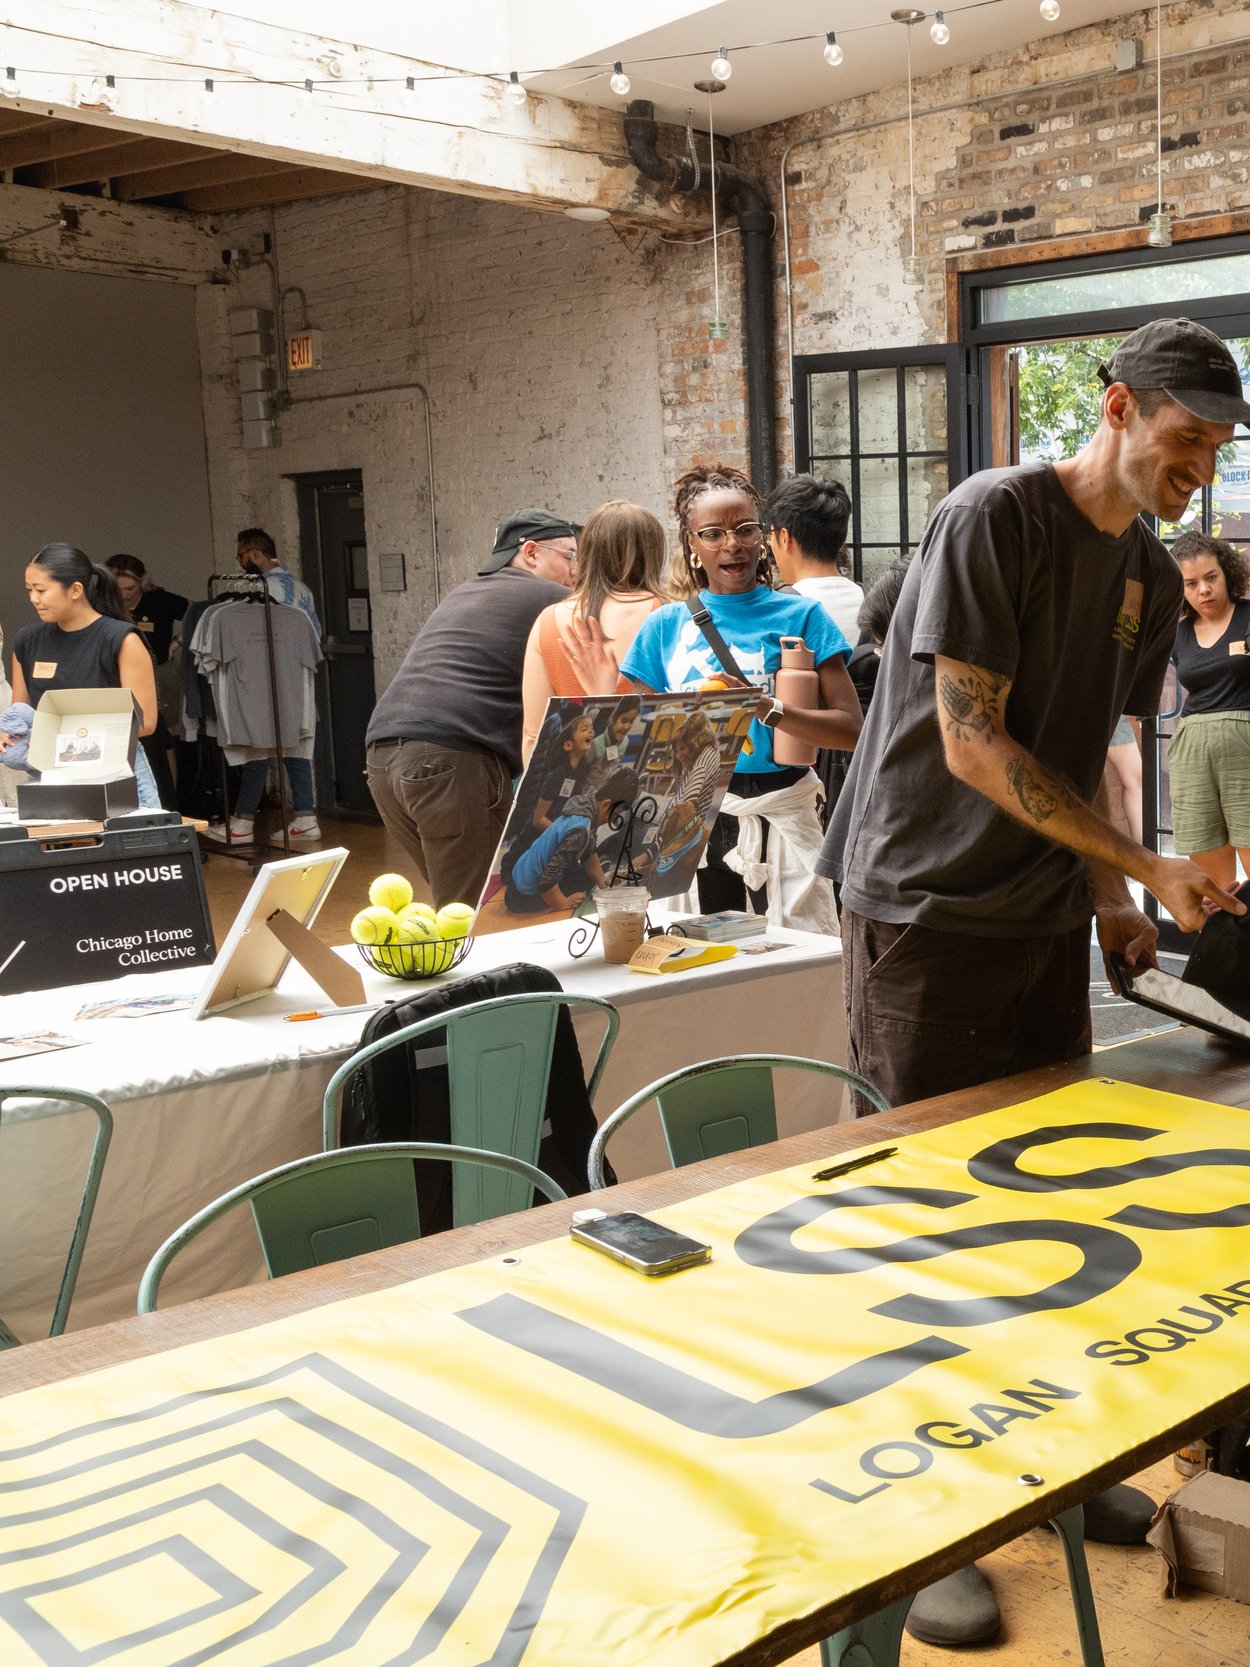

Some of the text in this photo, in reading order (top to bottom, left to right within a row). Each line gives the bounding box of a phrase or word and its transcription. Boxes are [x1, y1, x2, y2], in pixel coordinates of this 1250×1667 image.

[291, 336, 309, 365] EXIT
[50, 864, 183, 893] OPEN HOUSE
[76, 928, 193, 953] Chicago Home
[118, 945, 196, 966] Collective
[808, 1378, 1082, 1504] LOGAN
